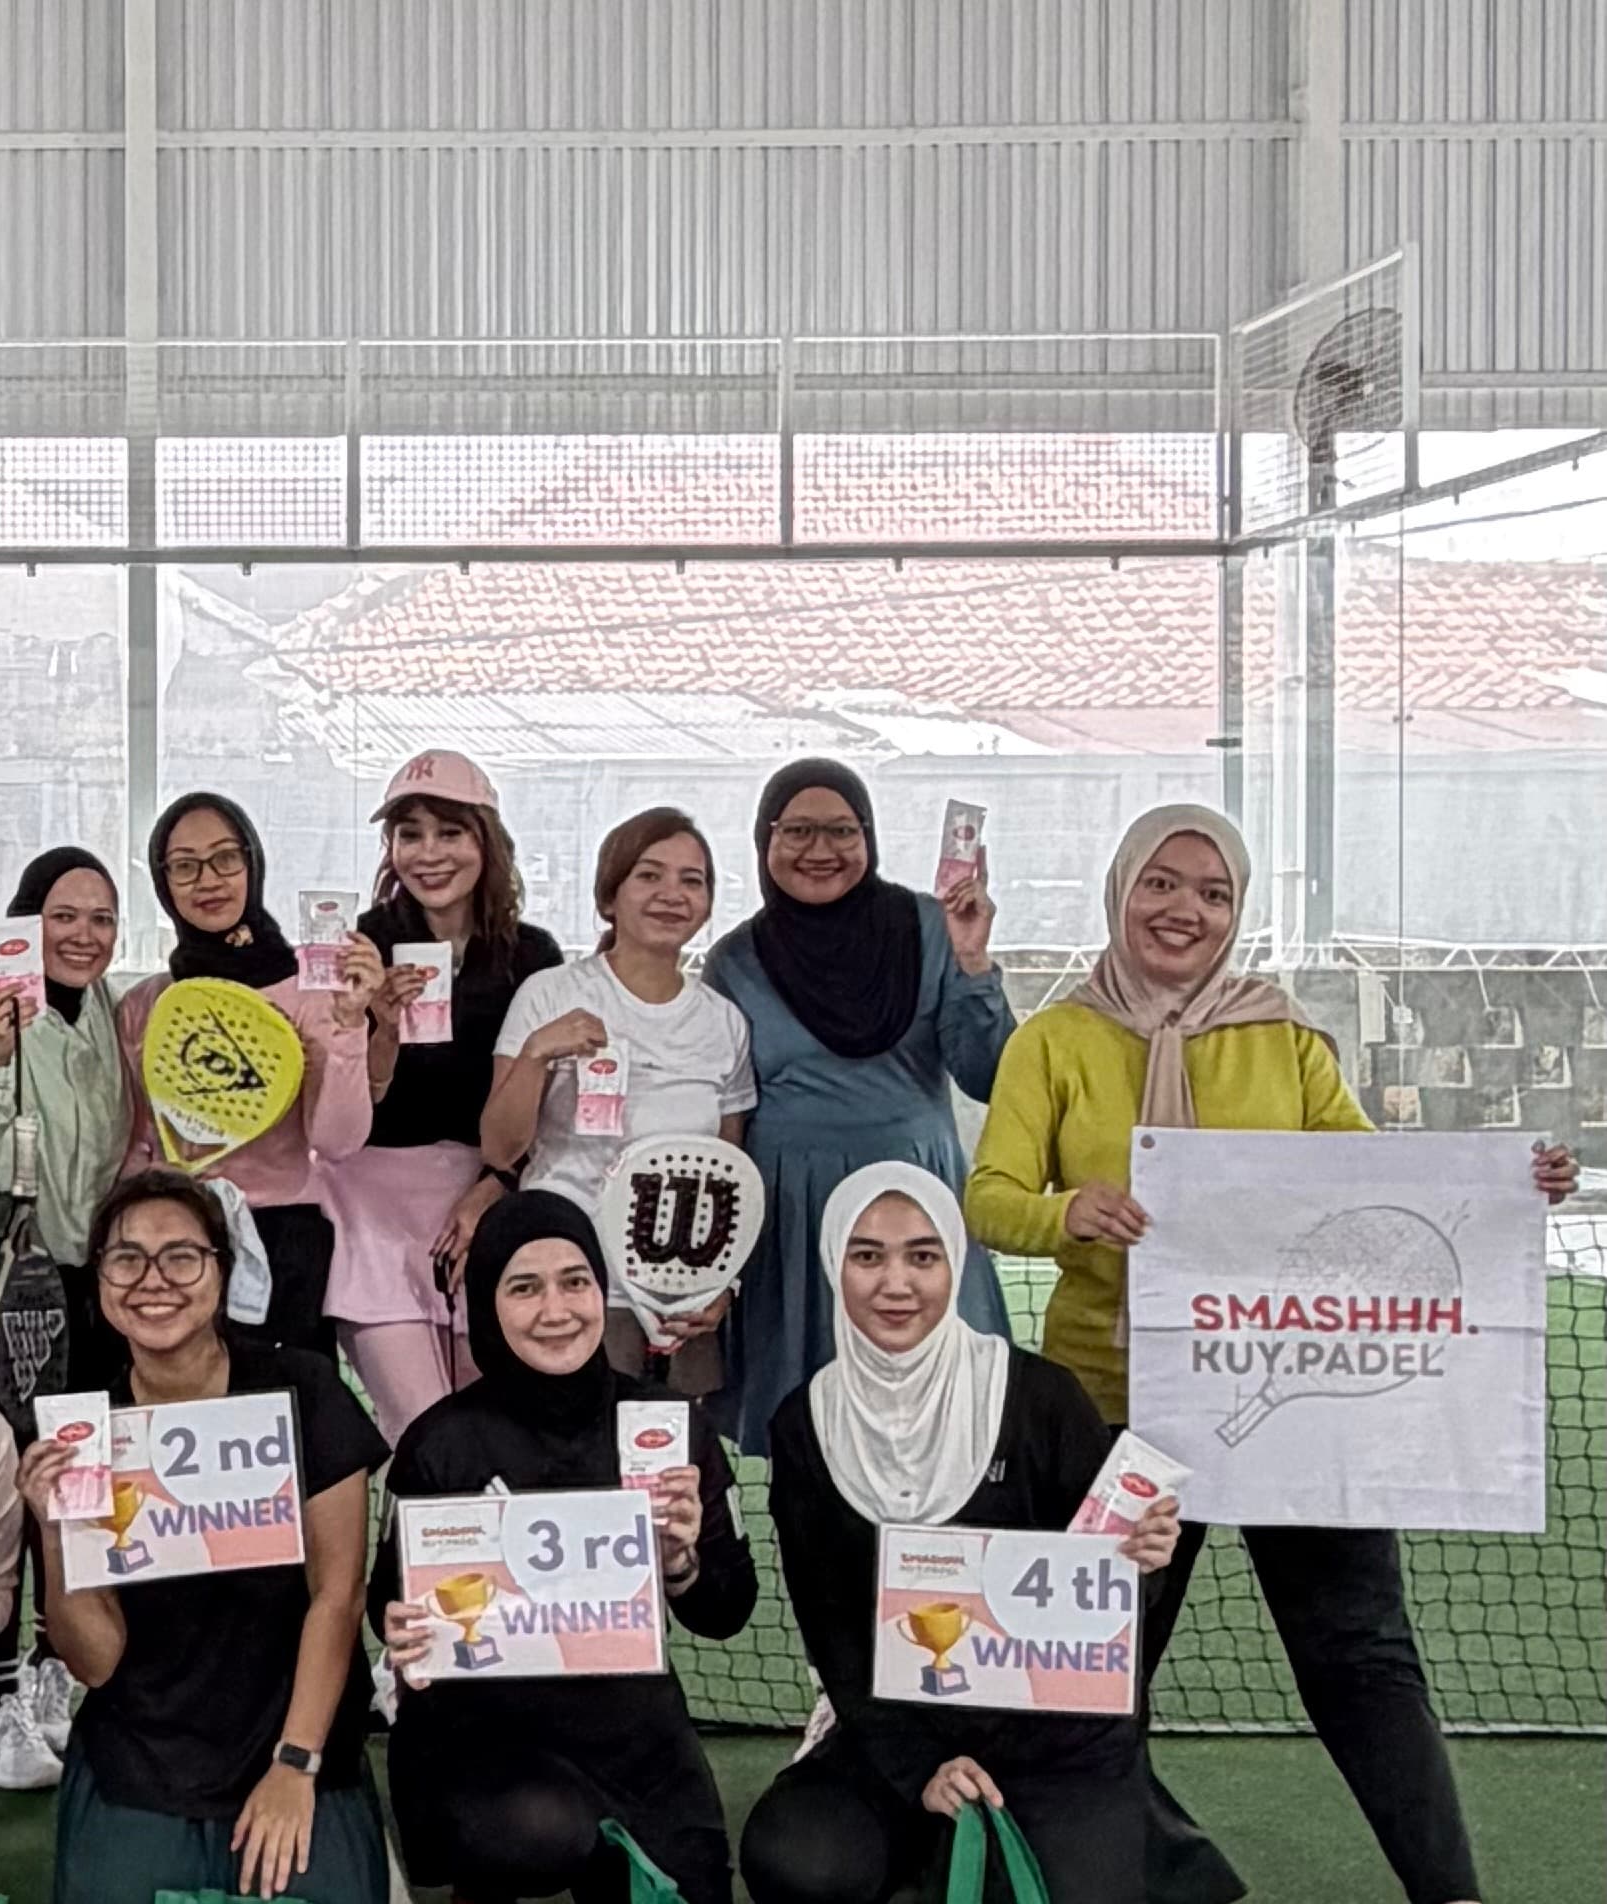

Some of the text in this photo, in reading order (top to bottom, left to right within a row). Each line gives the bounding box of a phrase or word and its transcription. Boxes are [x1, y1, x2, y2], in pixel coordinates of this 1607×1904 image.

[1191, 1294, 1479, 1335] SMASHHH.
[1192, 1339, 1445, 1377] KUY.PADEL
[160, 1415, 291, 1477] 2 nd
[147, 1497, 296, 1538] WINNER
[527, 1519, 565, 1572] 3
[583, 1514, 650, 1570] rd
[1011, 1557, 1054, 1608] 4
[1072, 1558, 1132, 1612] th
[499, 1597, 655, 1636] WINNER
[971, 1634, 1130, 1674] WINNER
